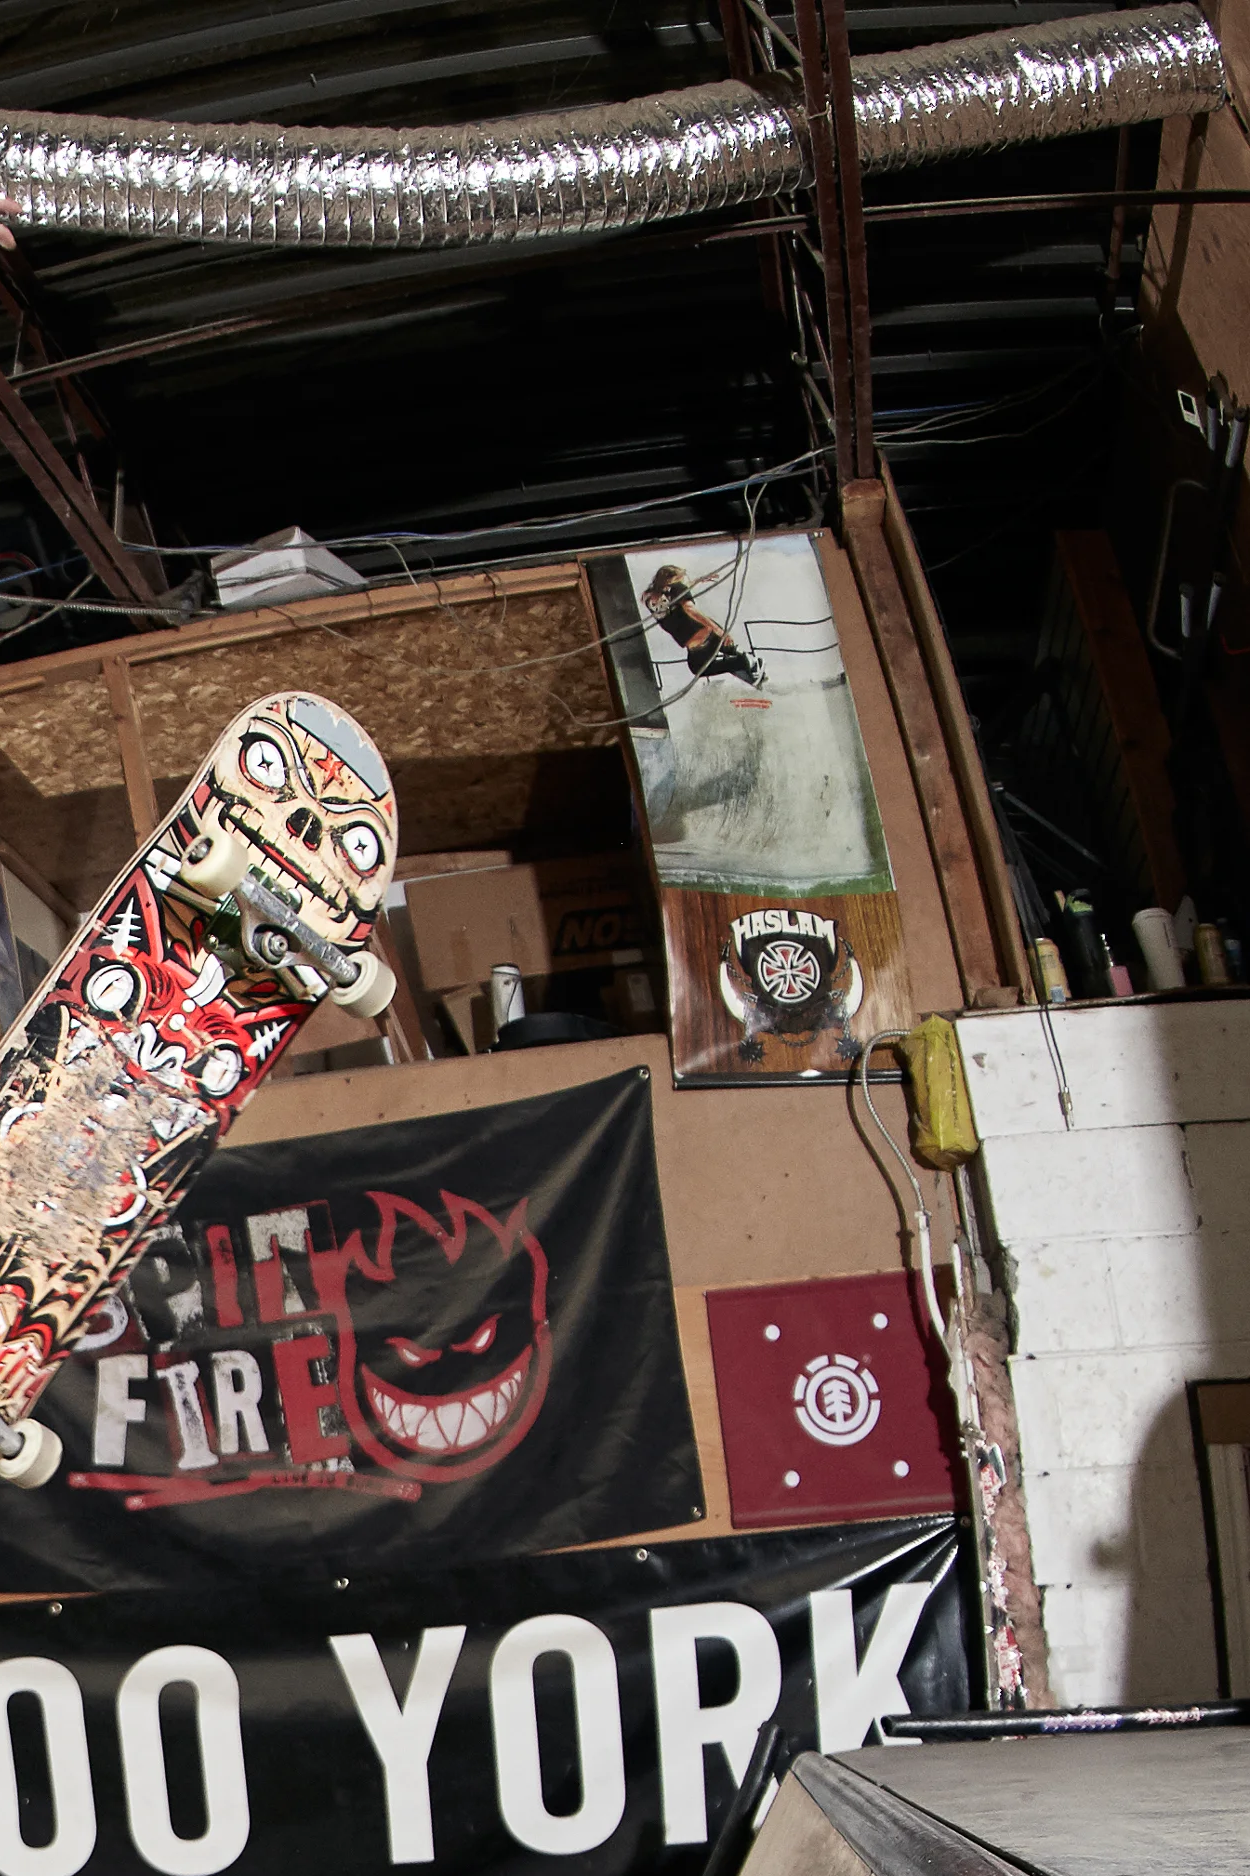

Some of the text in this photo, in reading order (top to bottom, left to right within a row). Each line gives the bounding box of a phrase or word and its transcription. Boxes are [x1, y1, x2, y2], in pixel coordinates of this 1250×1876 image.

[730, 908, 836, 957] HASLAM
[93, 1333, 352, 1470] FIRE
[329, 1581, 936, 1865] YORK
